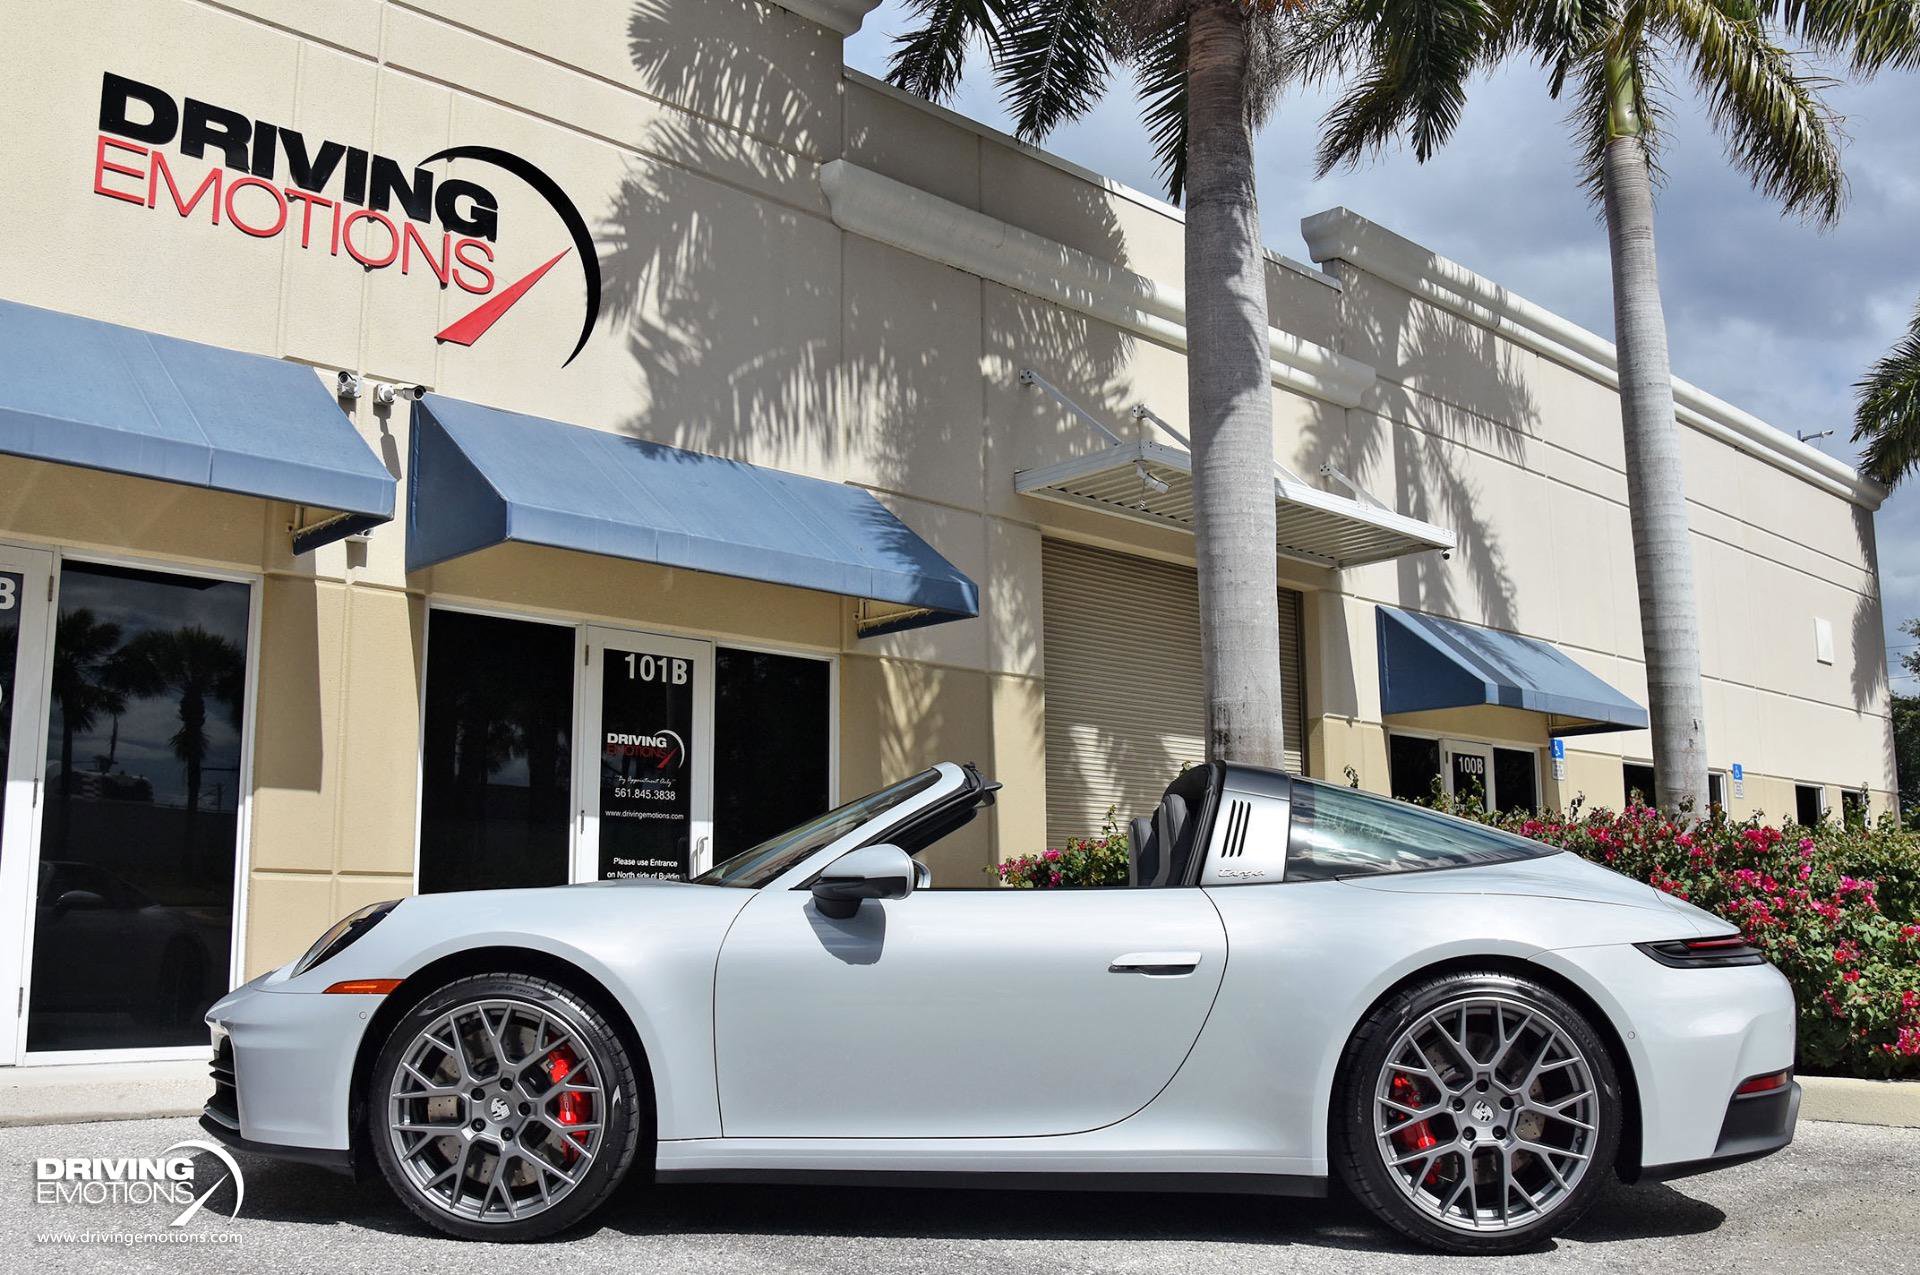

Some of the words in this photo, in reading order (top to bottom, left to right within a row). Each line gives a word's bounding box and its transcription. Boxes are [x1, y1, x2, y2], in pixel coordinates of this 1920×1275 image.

[98, 71, 499, 242] DRIVING
[94, 135, 495, 294] EMOTIONS
[625, 653, 688, 685] 101B
[607, 732, 667, 748] DRIVING
[1458, 755, 1484, 775] 100B
[614, 787, 676, 801] 561.845.3838
[605, 810, 685, 820] www.drivingemotions.com
[613, 857, 635, 866] Please
[650, 858, 678, 868] Entrance
[606, 871, 616, 879] on
[617, 870, 635, 879] North
[636, 871, 650, 879] side
[651, 871, 658, 880] of
[1217, 868, 1265, 880] Targa
